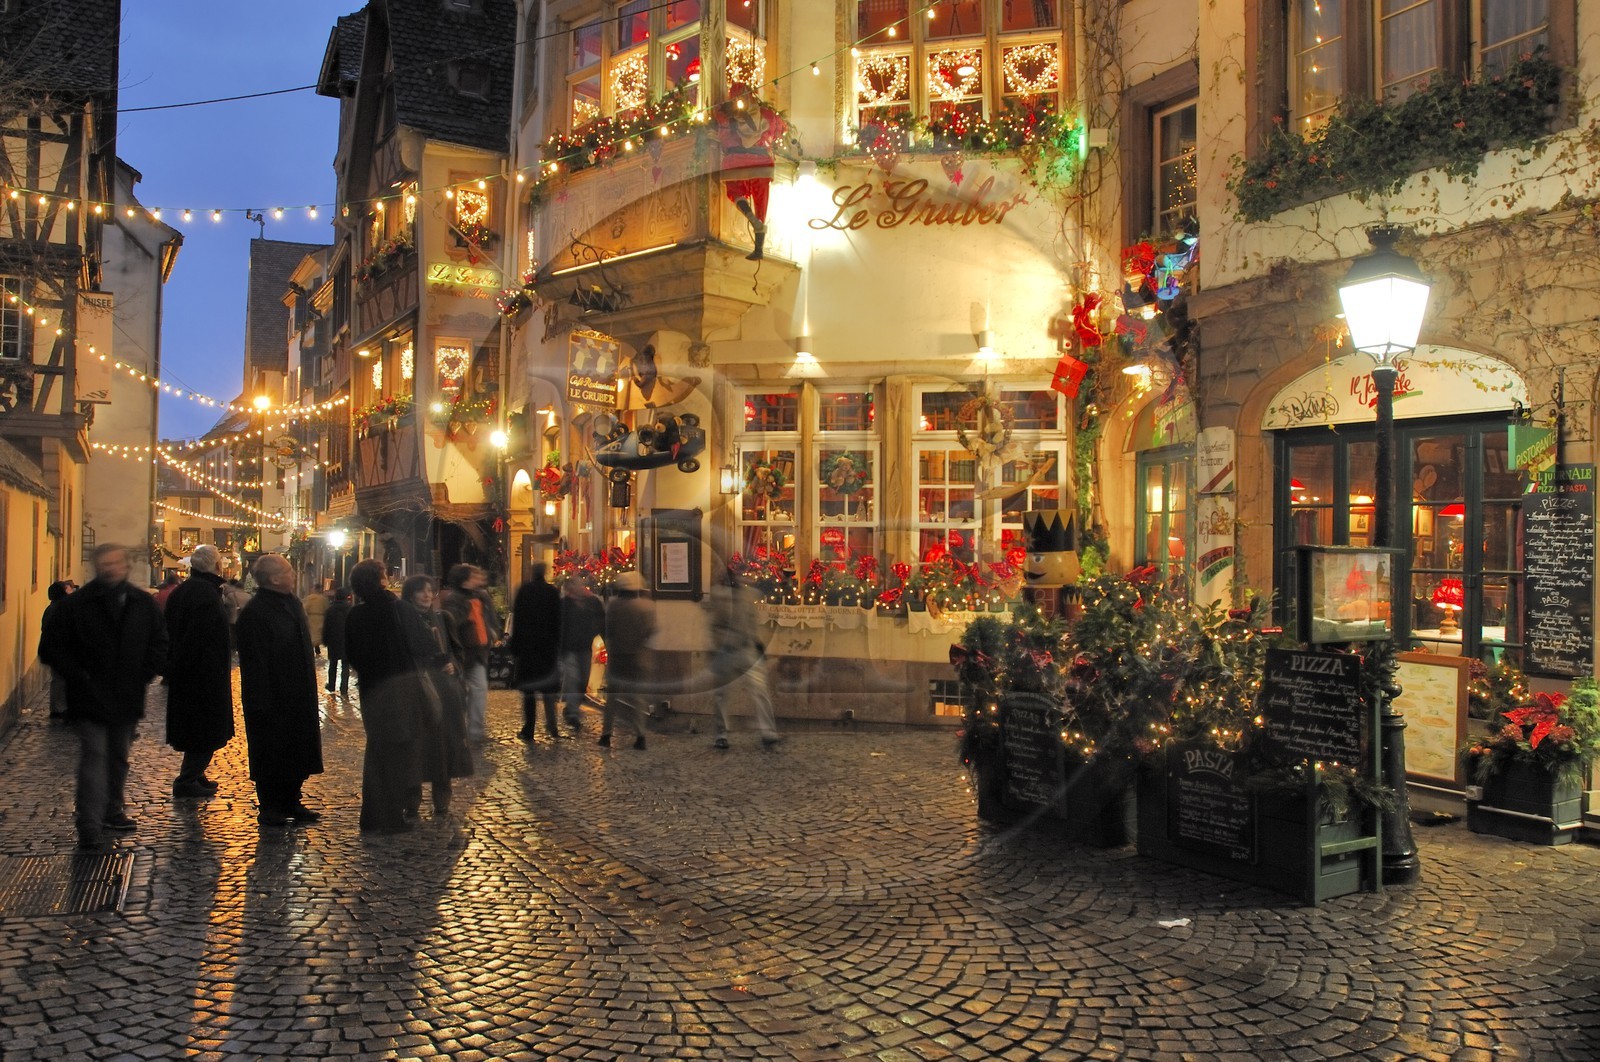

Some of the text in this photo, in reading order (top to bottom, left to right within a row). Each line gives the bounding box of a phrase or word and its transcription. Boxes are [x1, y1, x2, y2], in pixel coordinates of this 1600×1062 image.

[807, 177, 1018, 230] Le Gruber
[428, 264, 499, 287] Le Gruber
[570, 388, 616, 408] LE GRUBER
[1516, 430, 1558, 469] RISTORANTE
[1537, 485, 1558, 493] PIZZA
[1566, 484, 1589, 493] PASTA
[1205, 560, 1229, 581] Pasta
[1290, 654, 1345, 676] PIZZA
[1185, 749, 1235, 778] PASTA
